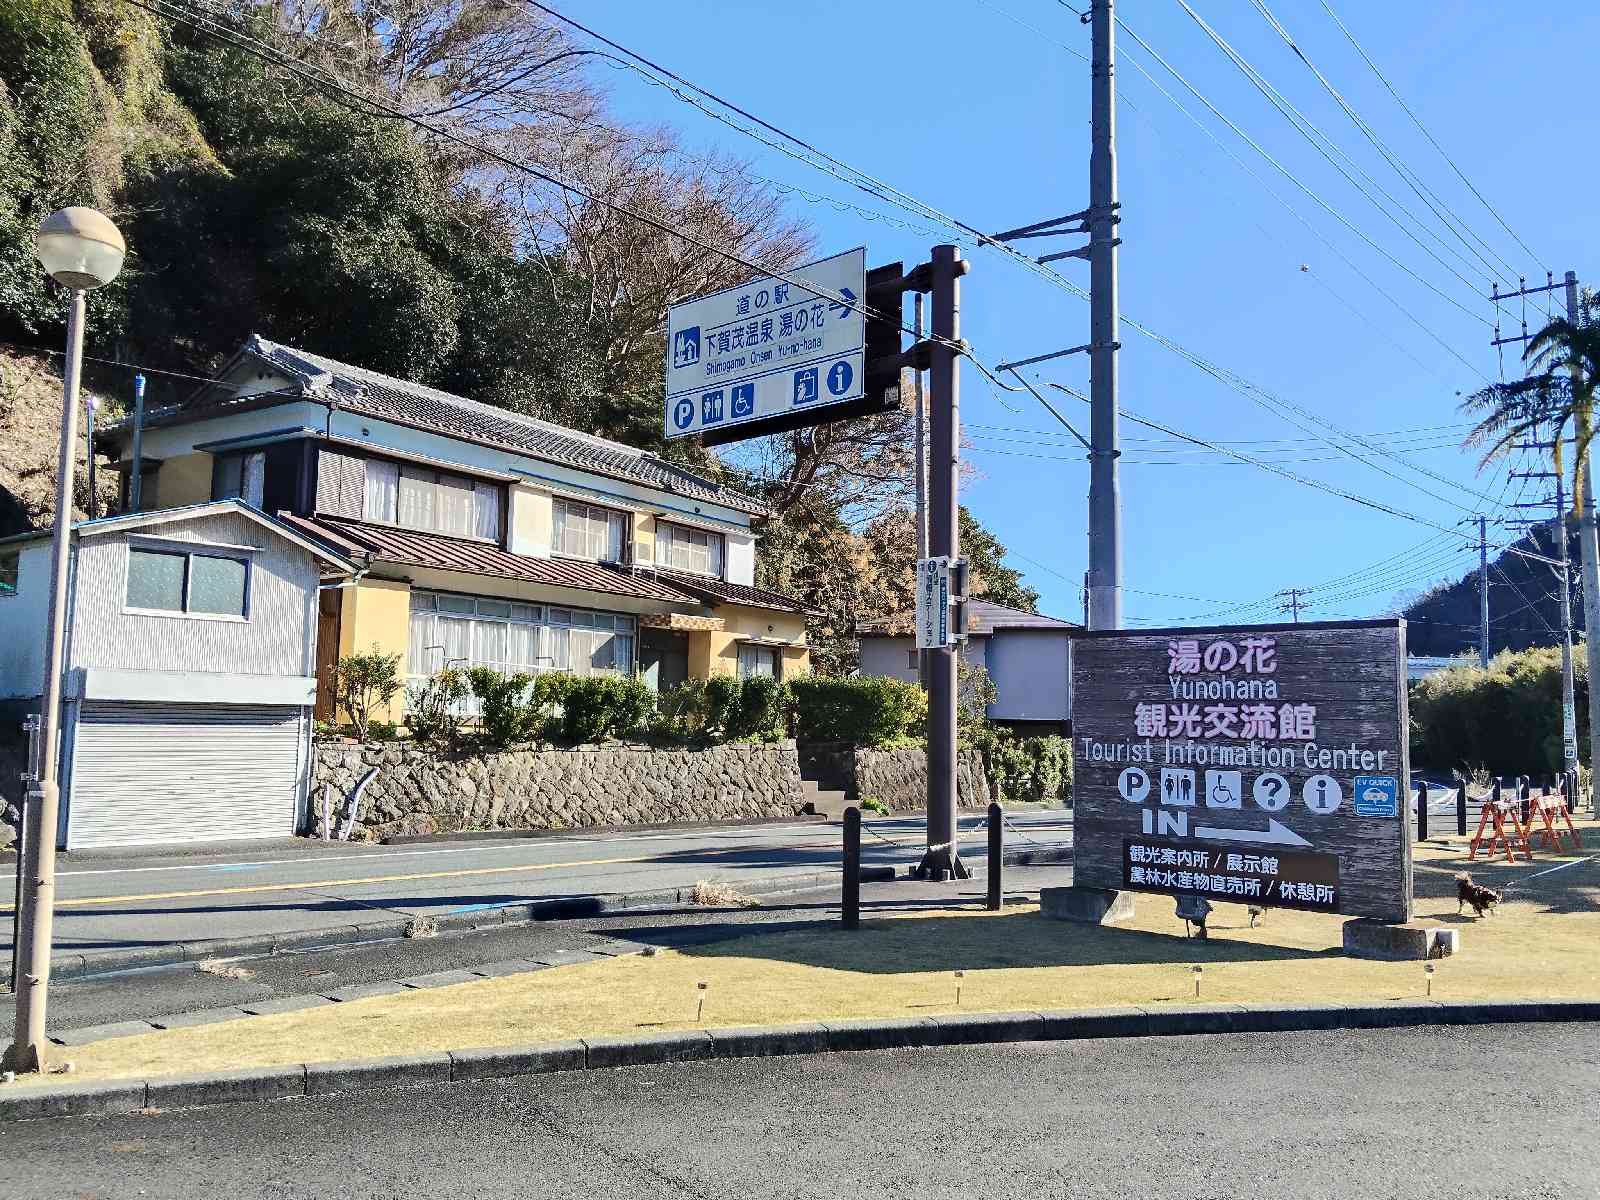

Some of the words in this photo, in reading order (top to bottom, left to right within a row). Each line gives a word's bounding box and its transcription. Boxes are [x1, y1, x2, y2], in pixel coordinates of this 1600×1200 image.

[735, 283, 790, 317] 道の駅
[704, 318, 774, 357] 下賀茂温泉
[779, 304, 825, 339] 湯の花
[706, 356, 746, 376] Shimogamo
[750, 348, 773, 364] Onsen
[1167, 637, 1278, 675] 湯の花
[1168, 675, 1278, 700] Yunohana
[1134, 702, 1318, 740] 観光交流館
[1082, 738, 1154, 764] Tourist
[1165, 738, 1296, 767] Information
[1303, 742, 1388, 770] Center
[1142, 808, 1188, 837] IN
[1129, 845, 1209, 869] 観光案内所
[1226, 853, 1279, 875] 展示館
[1130, 866, 1261, 897] 農林水産物直売所
[1279, 880, 1335, 904] 休憩所
